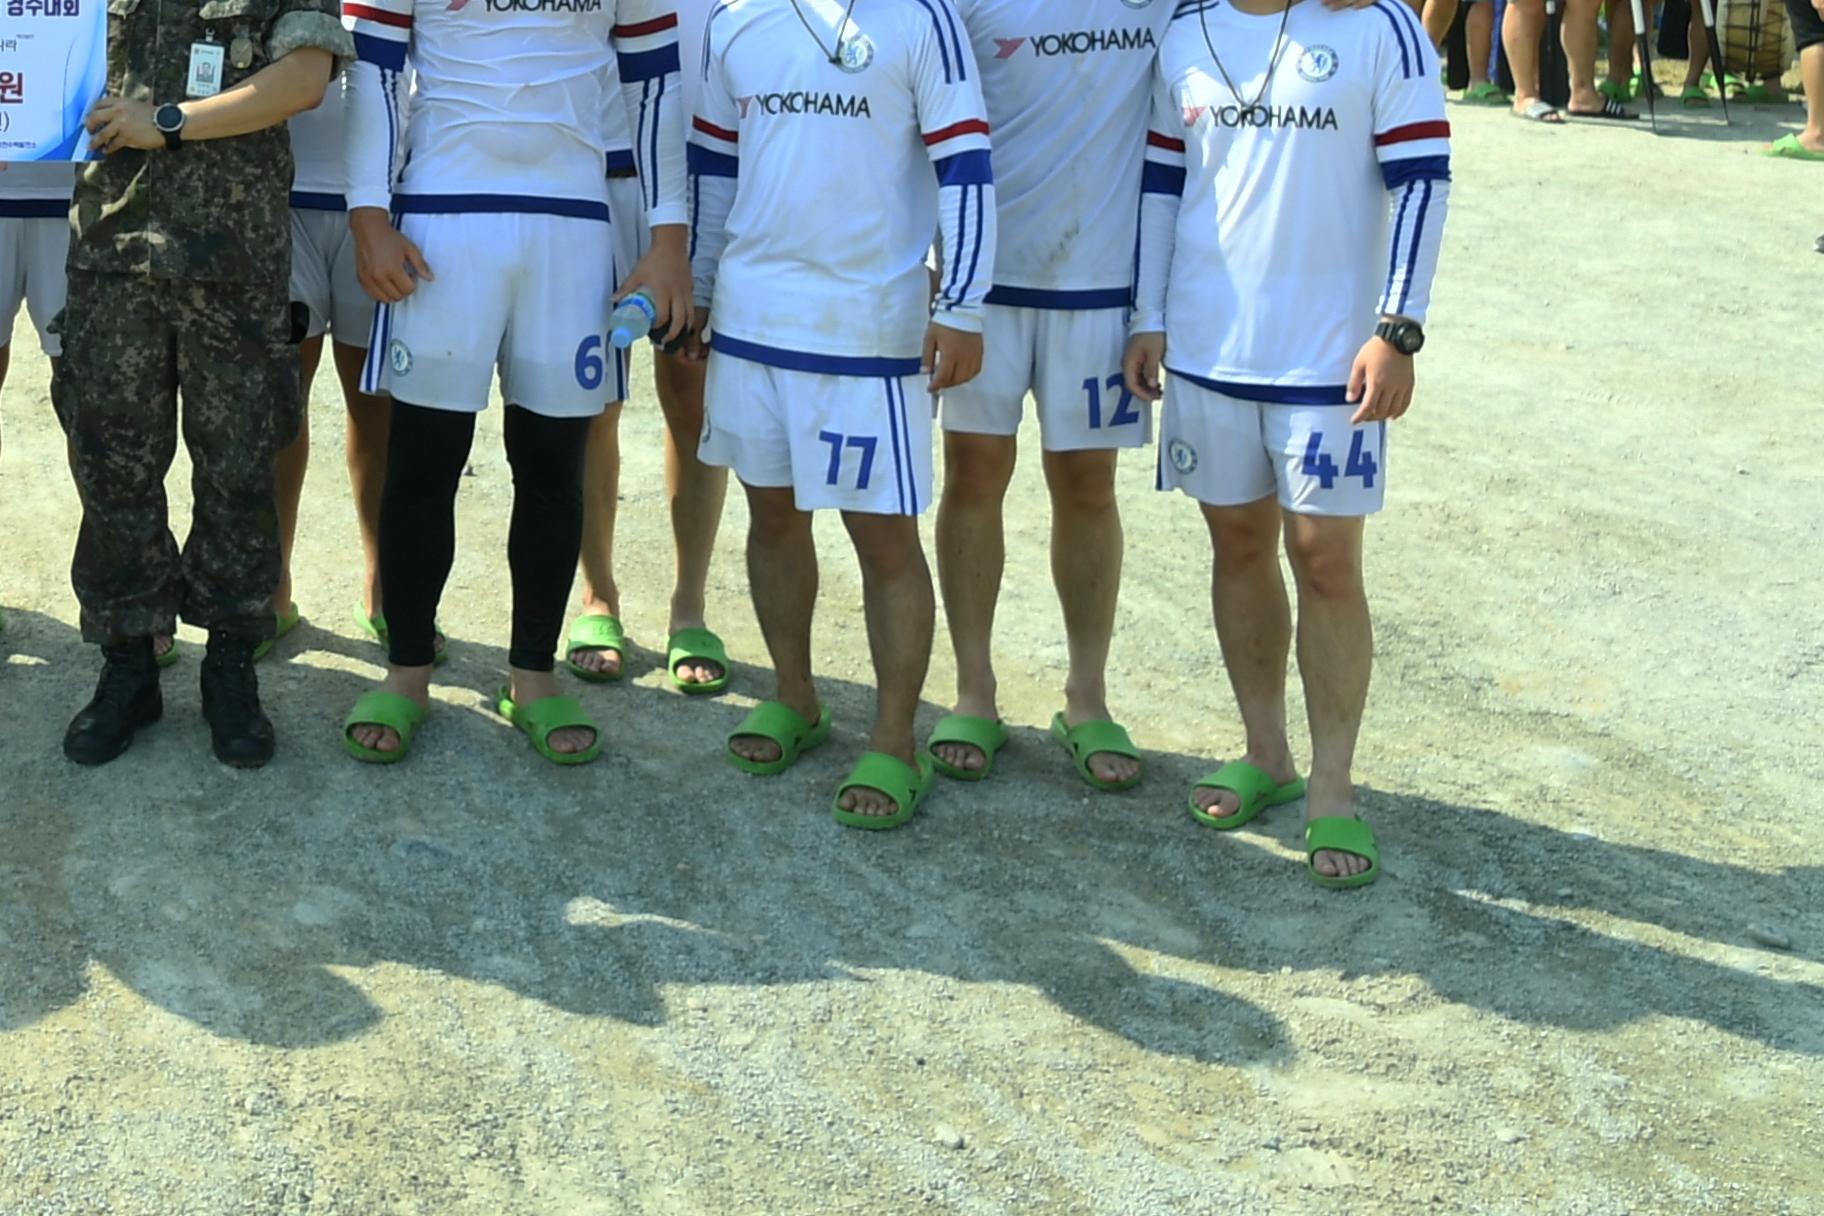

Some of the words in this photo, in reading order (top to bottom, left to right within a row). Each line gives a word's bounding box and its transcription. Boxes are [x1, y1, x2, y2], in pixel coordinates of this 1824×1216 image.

[1030, 27, 1156, 57] YOKOHAMA
[755, 92, 871, 119] YOKOHAMA
[1210, 104, 1339, 131] YOKOHAMA
[575, 330, 611, 391] 6
[1082, 373, 1140, 429] 12
[1302, 430, 1376, 490] 44
